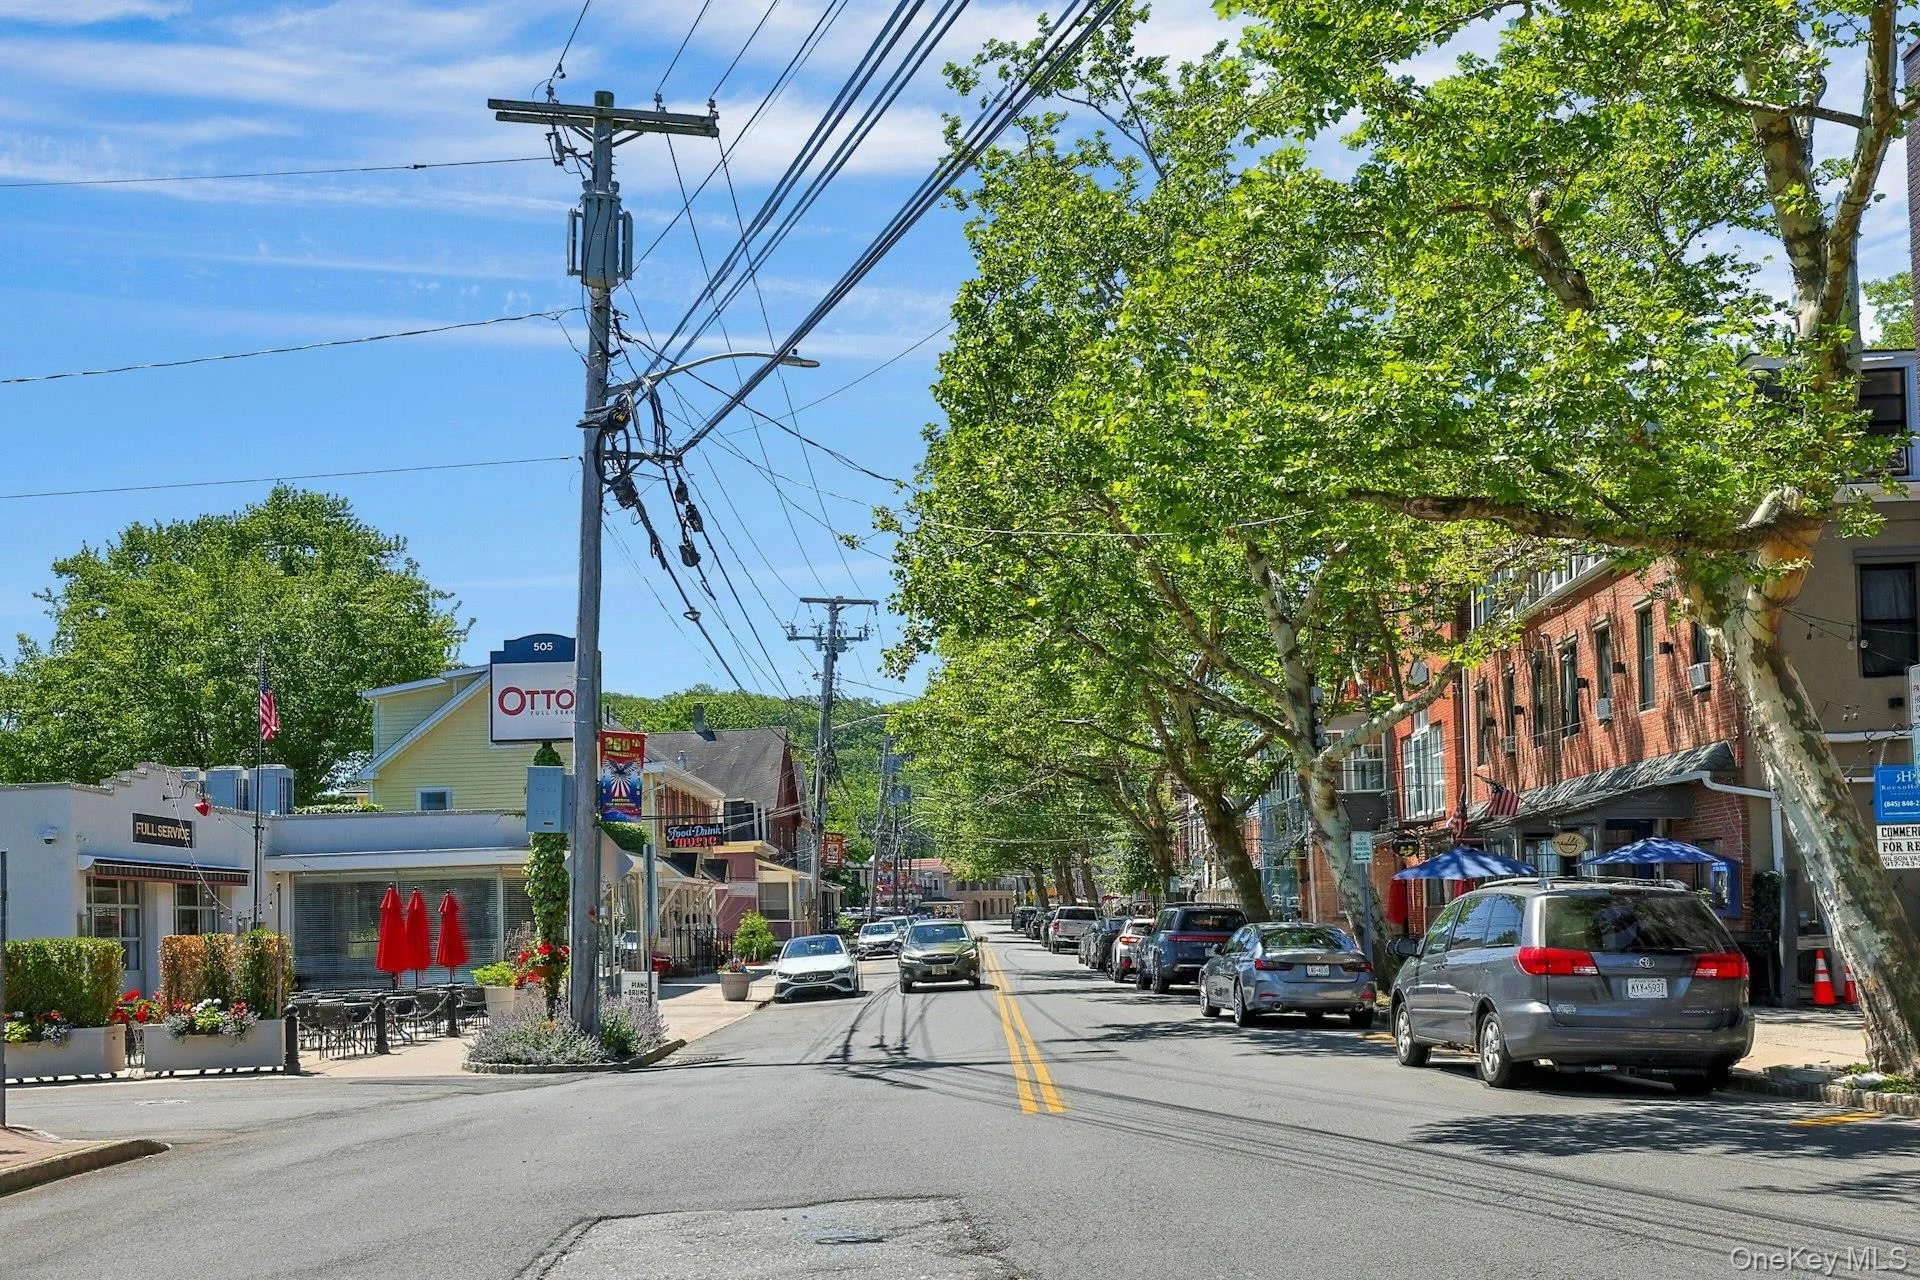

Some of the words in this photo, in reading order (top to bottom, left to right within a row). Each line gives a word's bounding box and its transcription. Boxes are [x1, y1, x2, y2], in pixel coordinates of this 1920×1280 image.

[533, 642, 553, 651] 505
[135, 821, 157, 837] FULL
[157, 824, 191, 841] SERVICE
[1882, 841, 1904, 852] FOR
